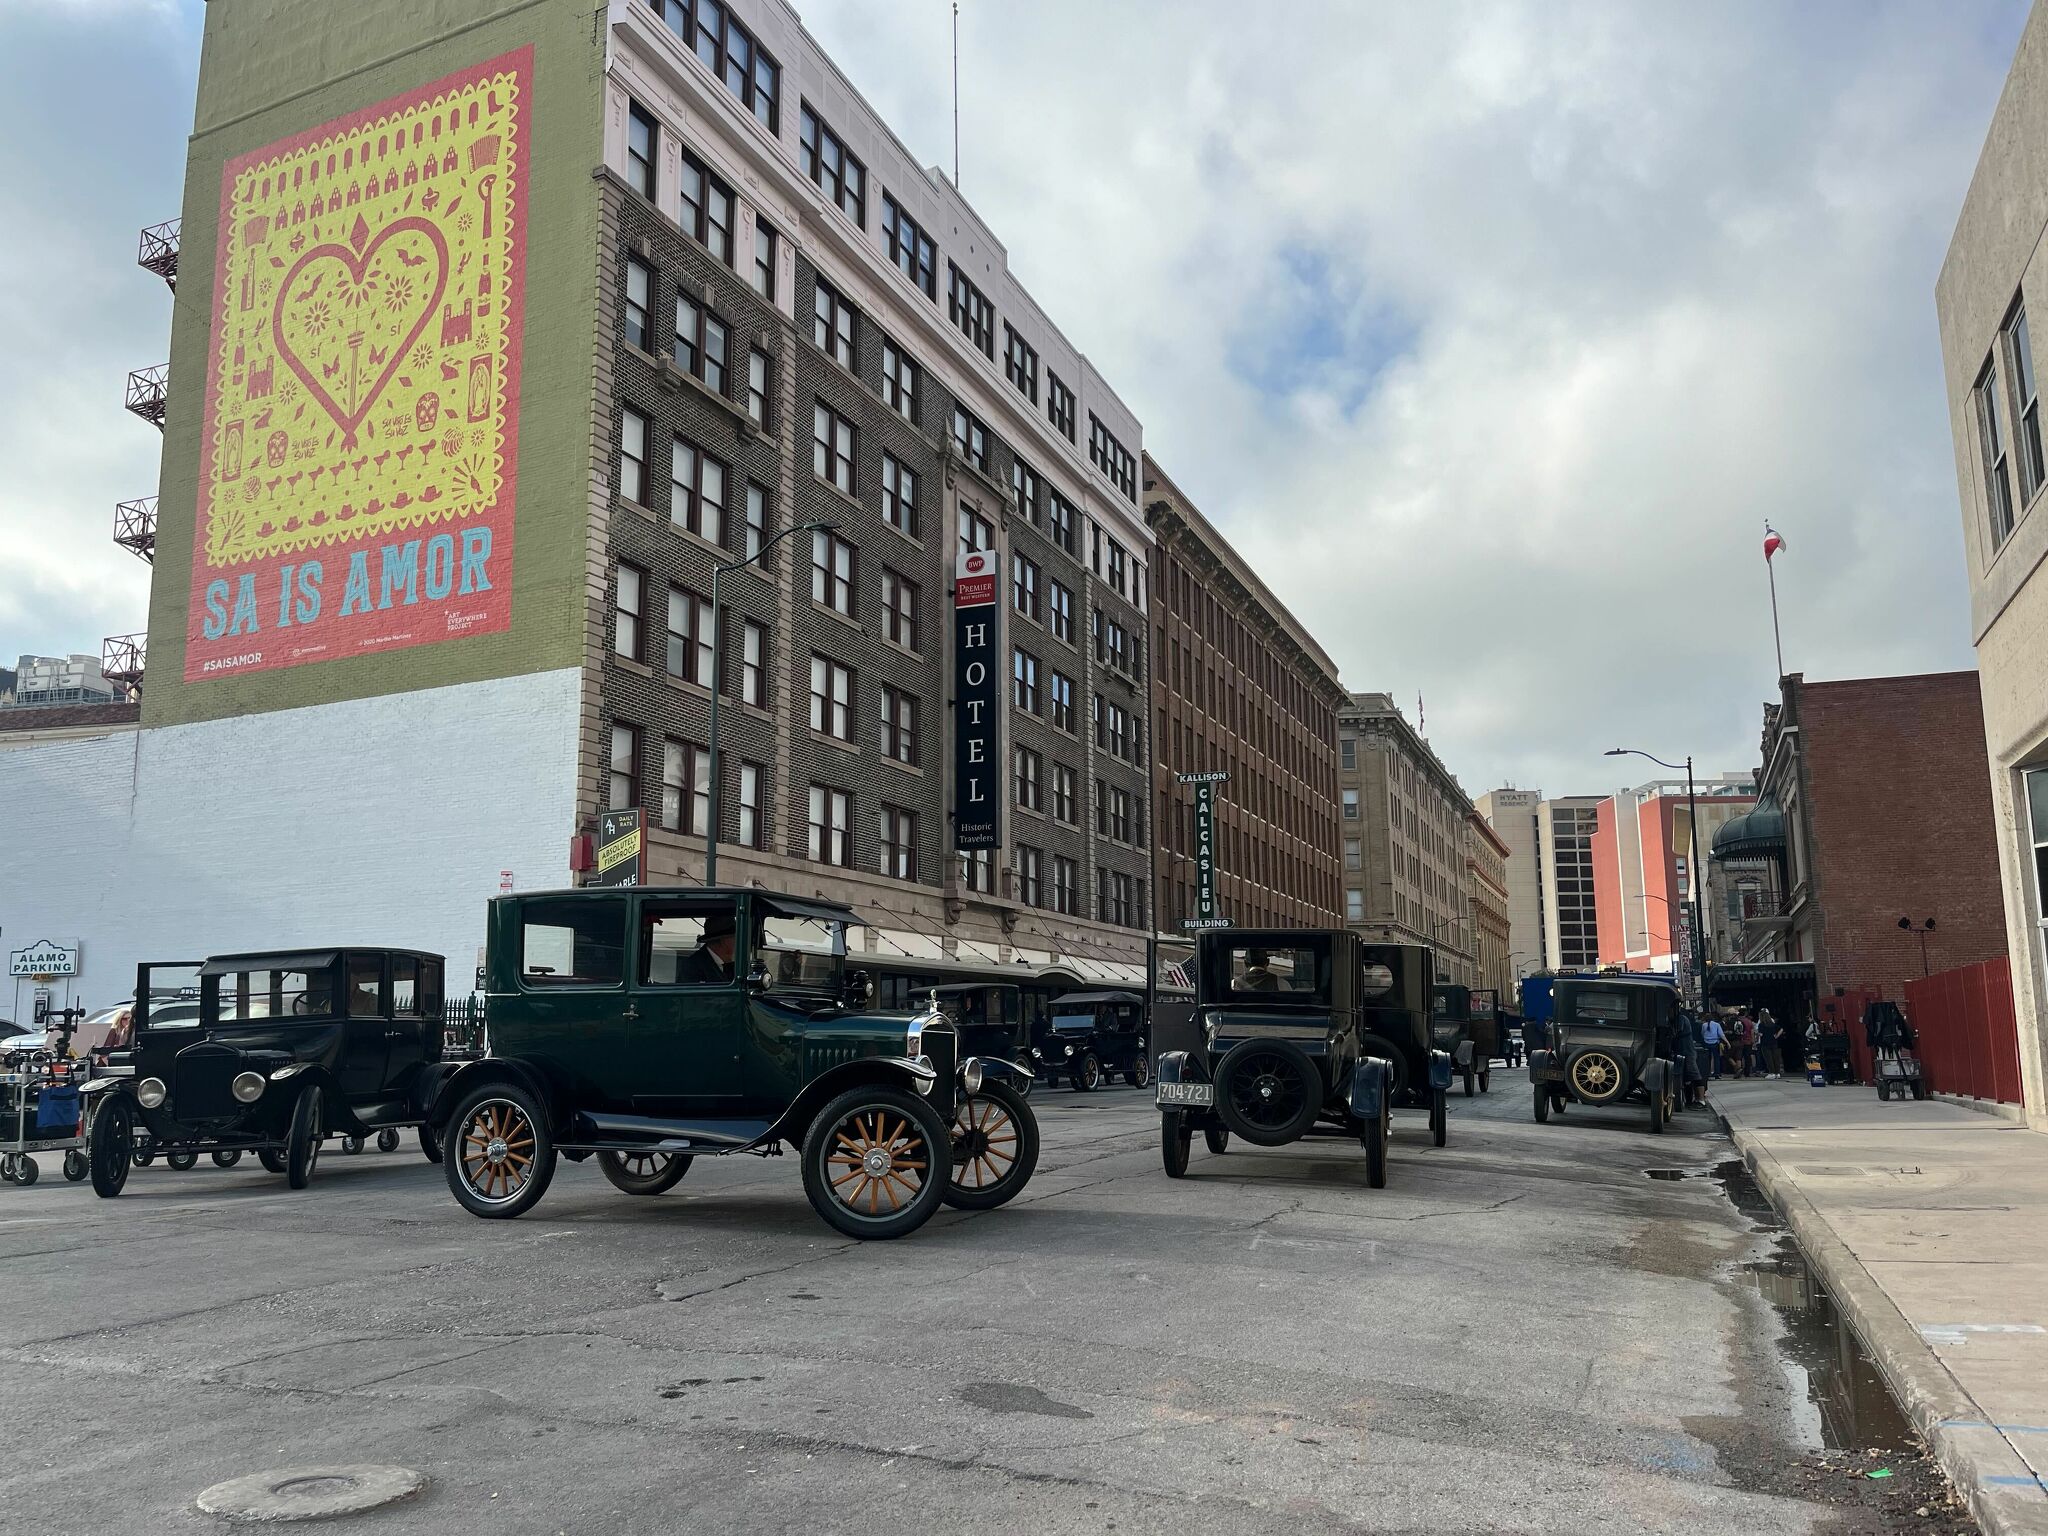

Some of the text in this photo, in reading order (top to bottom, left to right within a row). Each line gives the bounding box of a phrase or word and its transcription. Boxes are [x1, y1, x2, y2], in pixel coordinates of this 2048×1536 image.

[203, 526, 493, 641] SA IS AMOR
[959, 583, 993, 594] PREMIER
[447, 612, 488, 625] EVERYWHERE
[447, 622, 472, 631] PROJECT
[203, 652, 262, 672] #SAISAMOR
[965, 623, 986, 802] HOTEL
[1179, 772, 1227, 783] KALLISON
[961, 822, 993, 832] Historic
[959, 834, 994, 844] Travelers
[602, 834, 638, 860] ABSOLUTELY
[1199, 788, 1211, 913] CALCASIEU
[604, 843, 636, 867] FIREPROOF
[1184, 919, 1229, 928] BUILDING
[19, 953, 67, 962] ALAMO
[14, 963, 72, 973] PARKING
